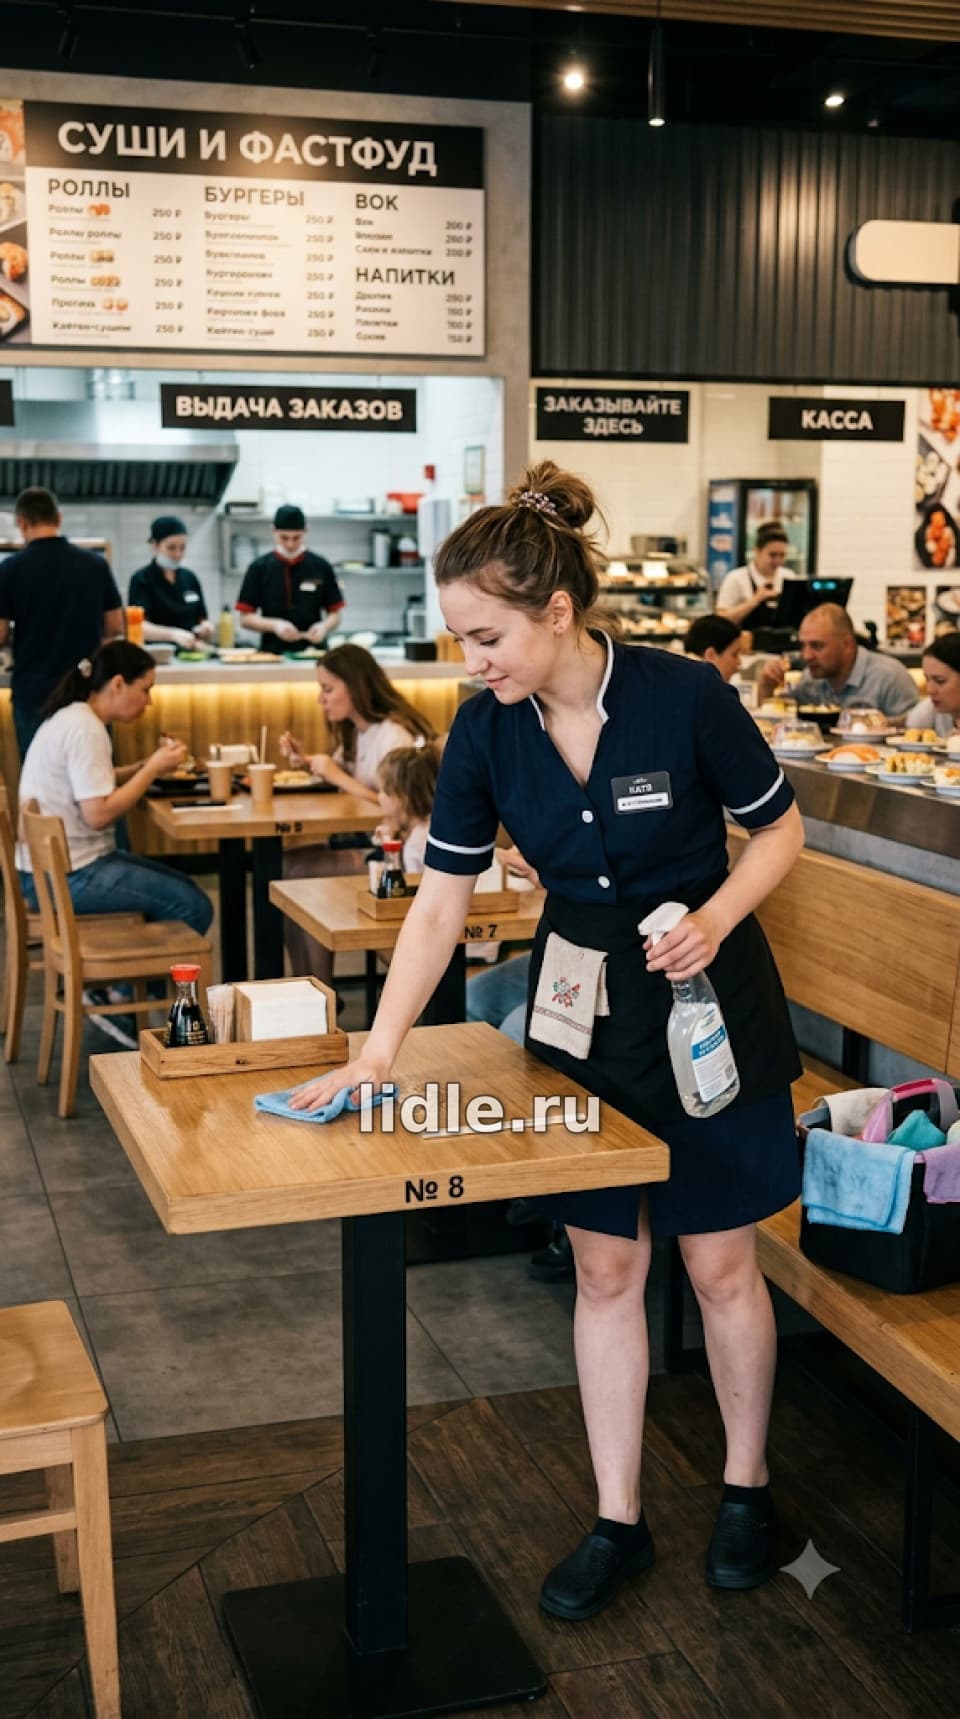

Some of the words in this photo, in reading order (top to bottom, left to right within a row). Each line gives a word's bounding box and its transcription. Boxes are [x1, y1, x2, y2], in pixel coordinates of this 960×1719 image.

[57, 121, 186, 160] СУШИ
[200, 128, 227, 161] И
[239, 130, 437, 177] ФАСТФУД
[48, 179, 131, 199] РОЛЛЫ
[204, 186, 305, 206] БУРГЕРЫ
[355, 193, 399, 211] ВОК
[356, 268, 456, 287] НАПИТКИ
[175, 396, 283, 421] ВЫДАЧА
[288, 397, 403, 421] ЗАКАЗОВ
[543, 394, 683, 416] ЗАКАЗЫВАЙТЕ
[583, 417, 644, 436] ЗДЕСЬ
[801, 410, 874, 432] КАССА
[464, 925, 483, 940] №
[487, 924, 498, 938] 7
[405, 1178, 439, 1204] №
[448, 1174, 465, 1199] 8
